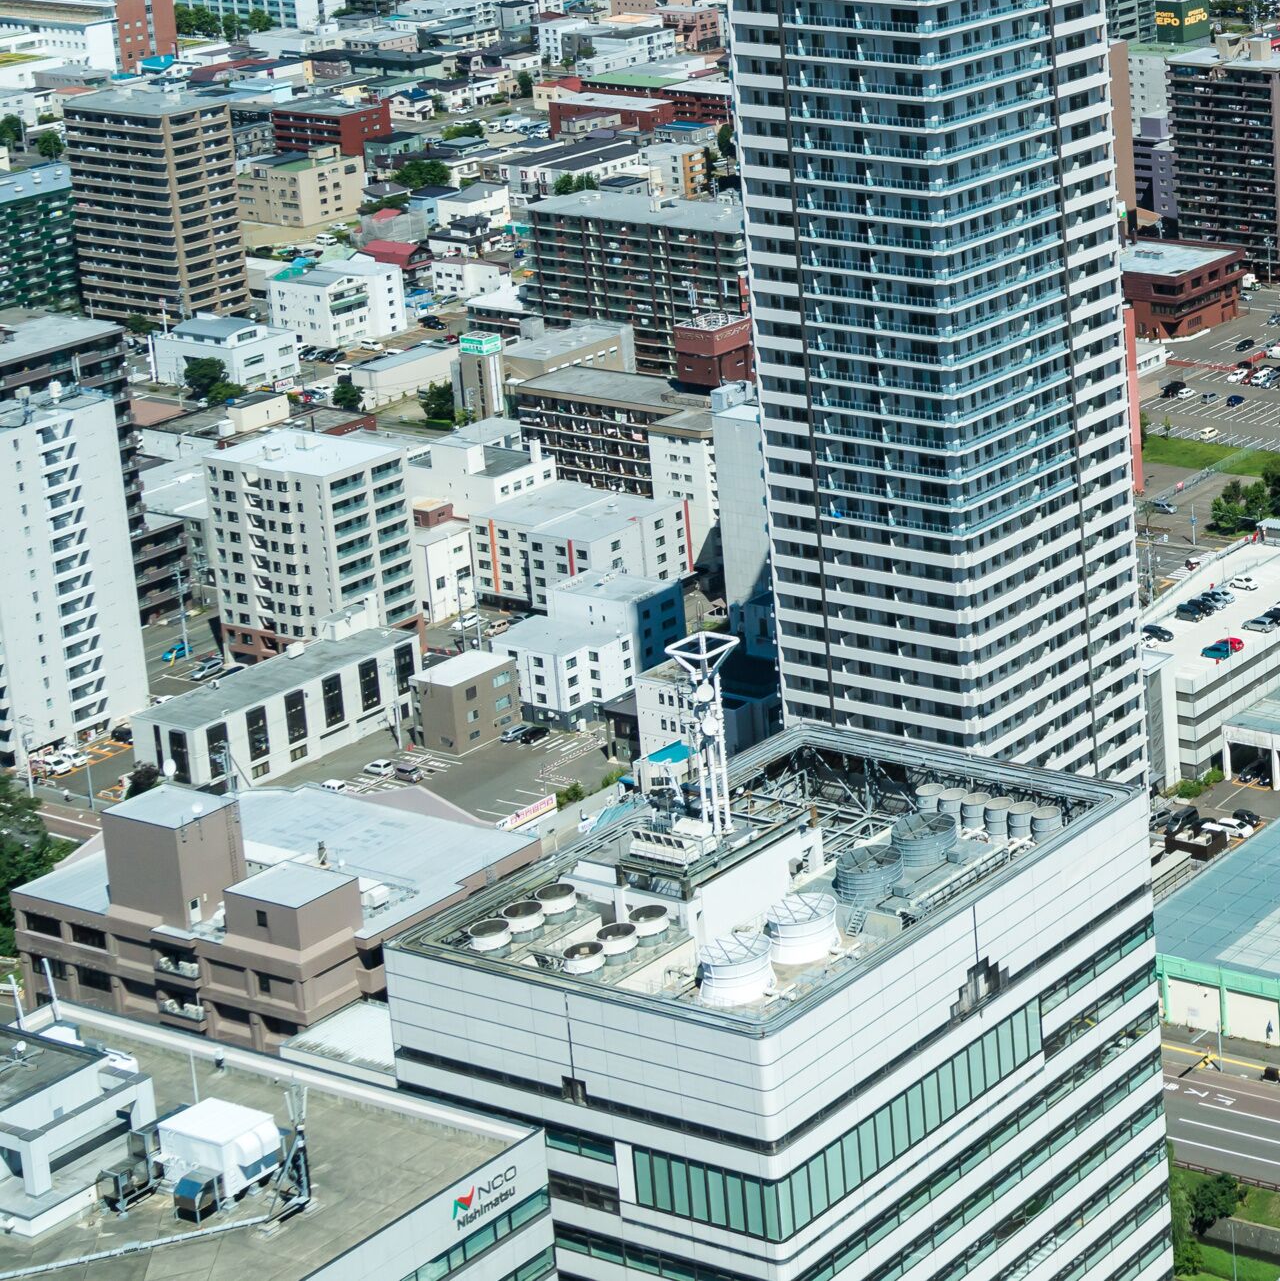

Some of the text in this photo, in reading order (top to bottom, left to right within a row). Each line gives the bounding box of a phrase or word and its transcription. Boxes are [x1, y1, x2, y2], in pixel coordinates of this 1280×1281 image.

[1184, 12, 1208, 26] DEPO
[1188, 7, 1204, 17] SPORTS
[1156, 17, 1180, 26] EPO
[477, 1165, 517, 1200] NCO
[457, 1186, 516, 1231] Nishimatsu
